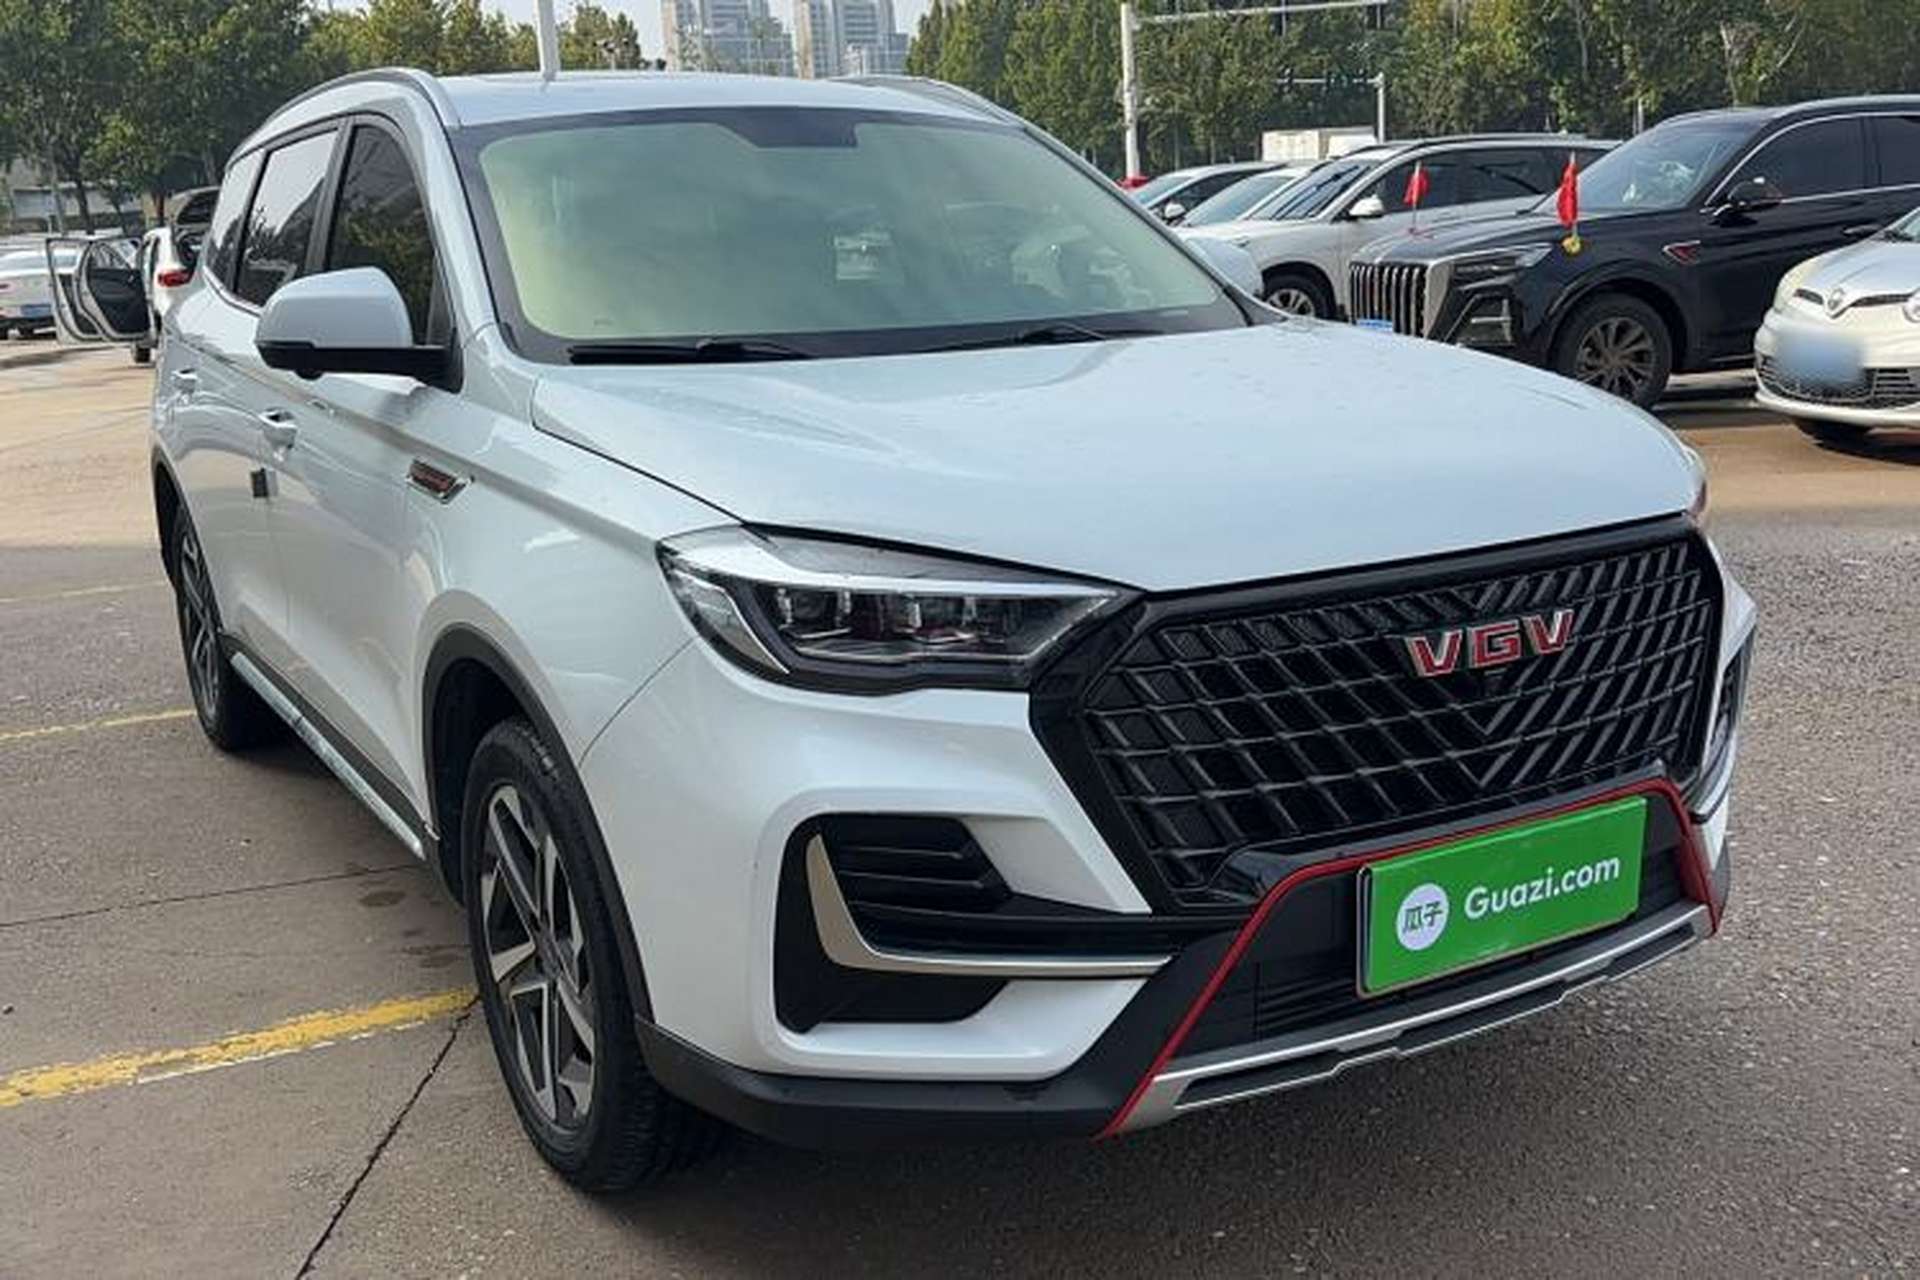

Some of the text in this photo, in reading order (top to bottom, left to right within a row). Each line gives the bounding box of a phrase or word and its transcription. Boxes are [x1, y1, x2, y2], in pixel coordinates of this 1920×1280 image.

[1404, 608, 1575, 678] VGV
[1402, 901, 1444, 934] 瓜子
[1464, 856, 1621, 920] Guazi.com
